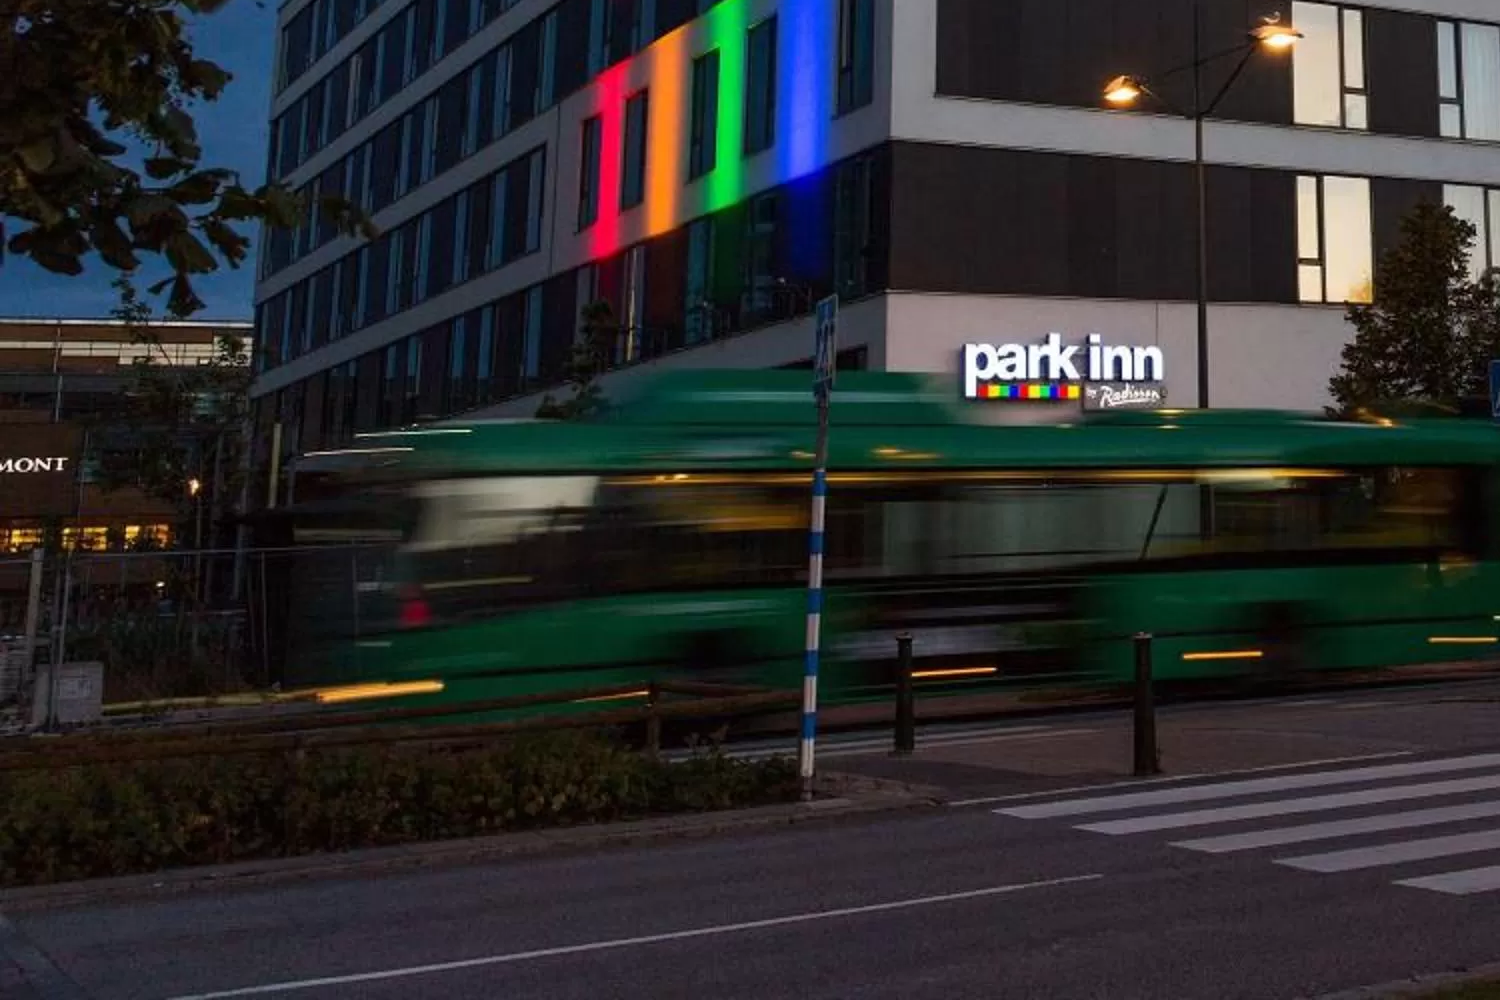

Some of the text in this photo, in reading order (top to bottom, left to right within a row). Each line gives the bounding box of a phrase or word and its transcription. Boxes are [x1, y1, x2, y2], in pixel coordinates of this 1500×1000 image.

[964, 332, 1164, 398] park inn
[1099, 382, 1161, 408] Radisson
